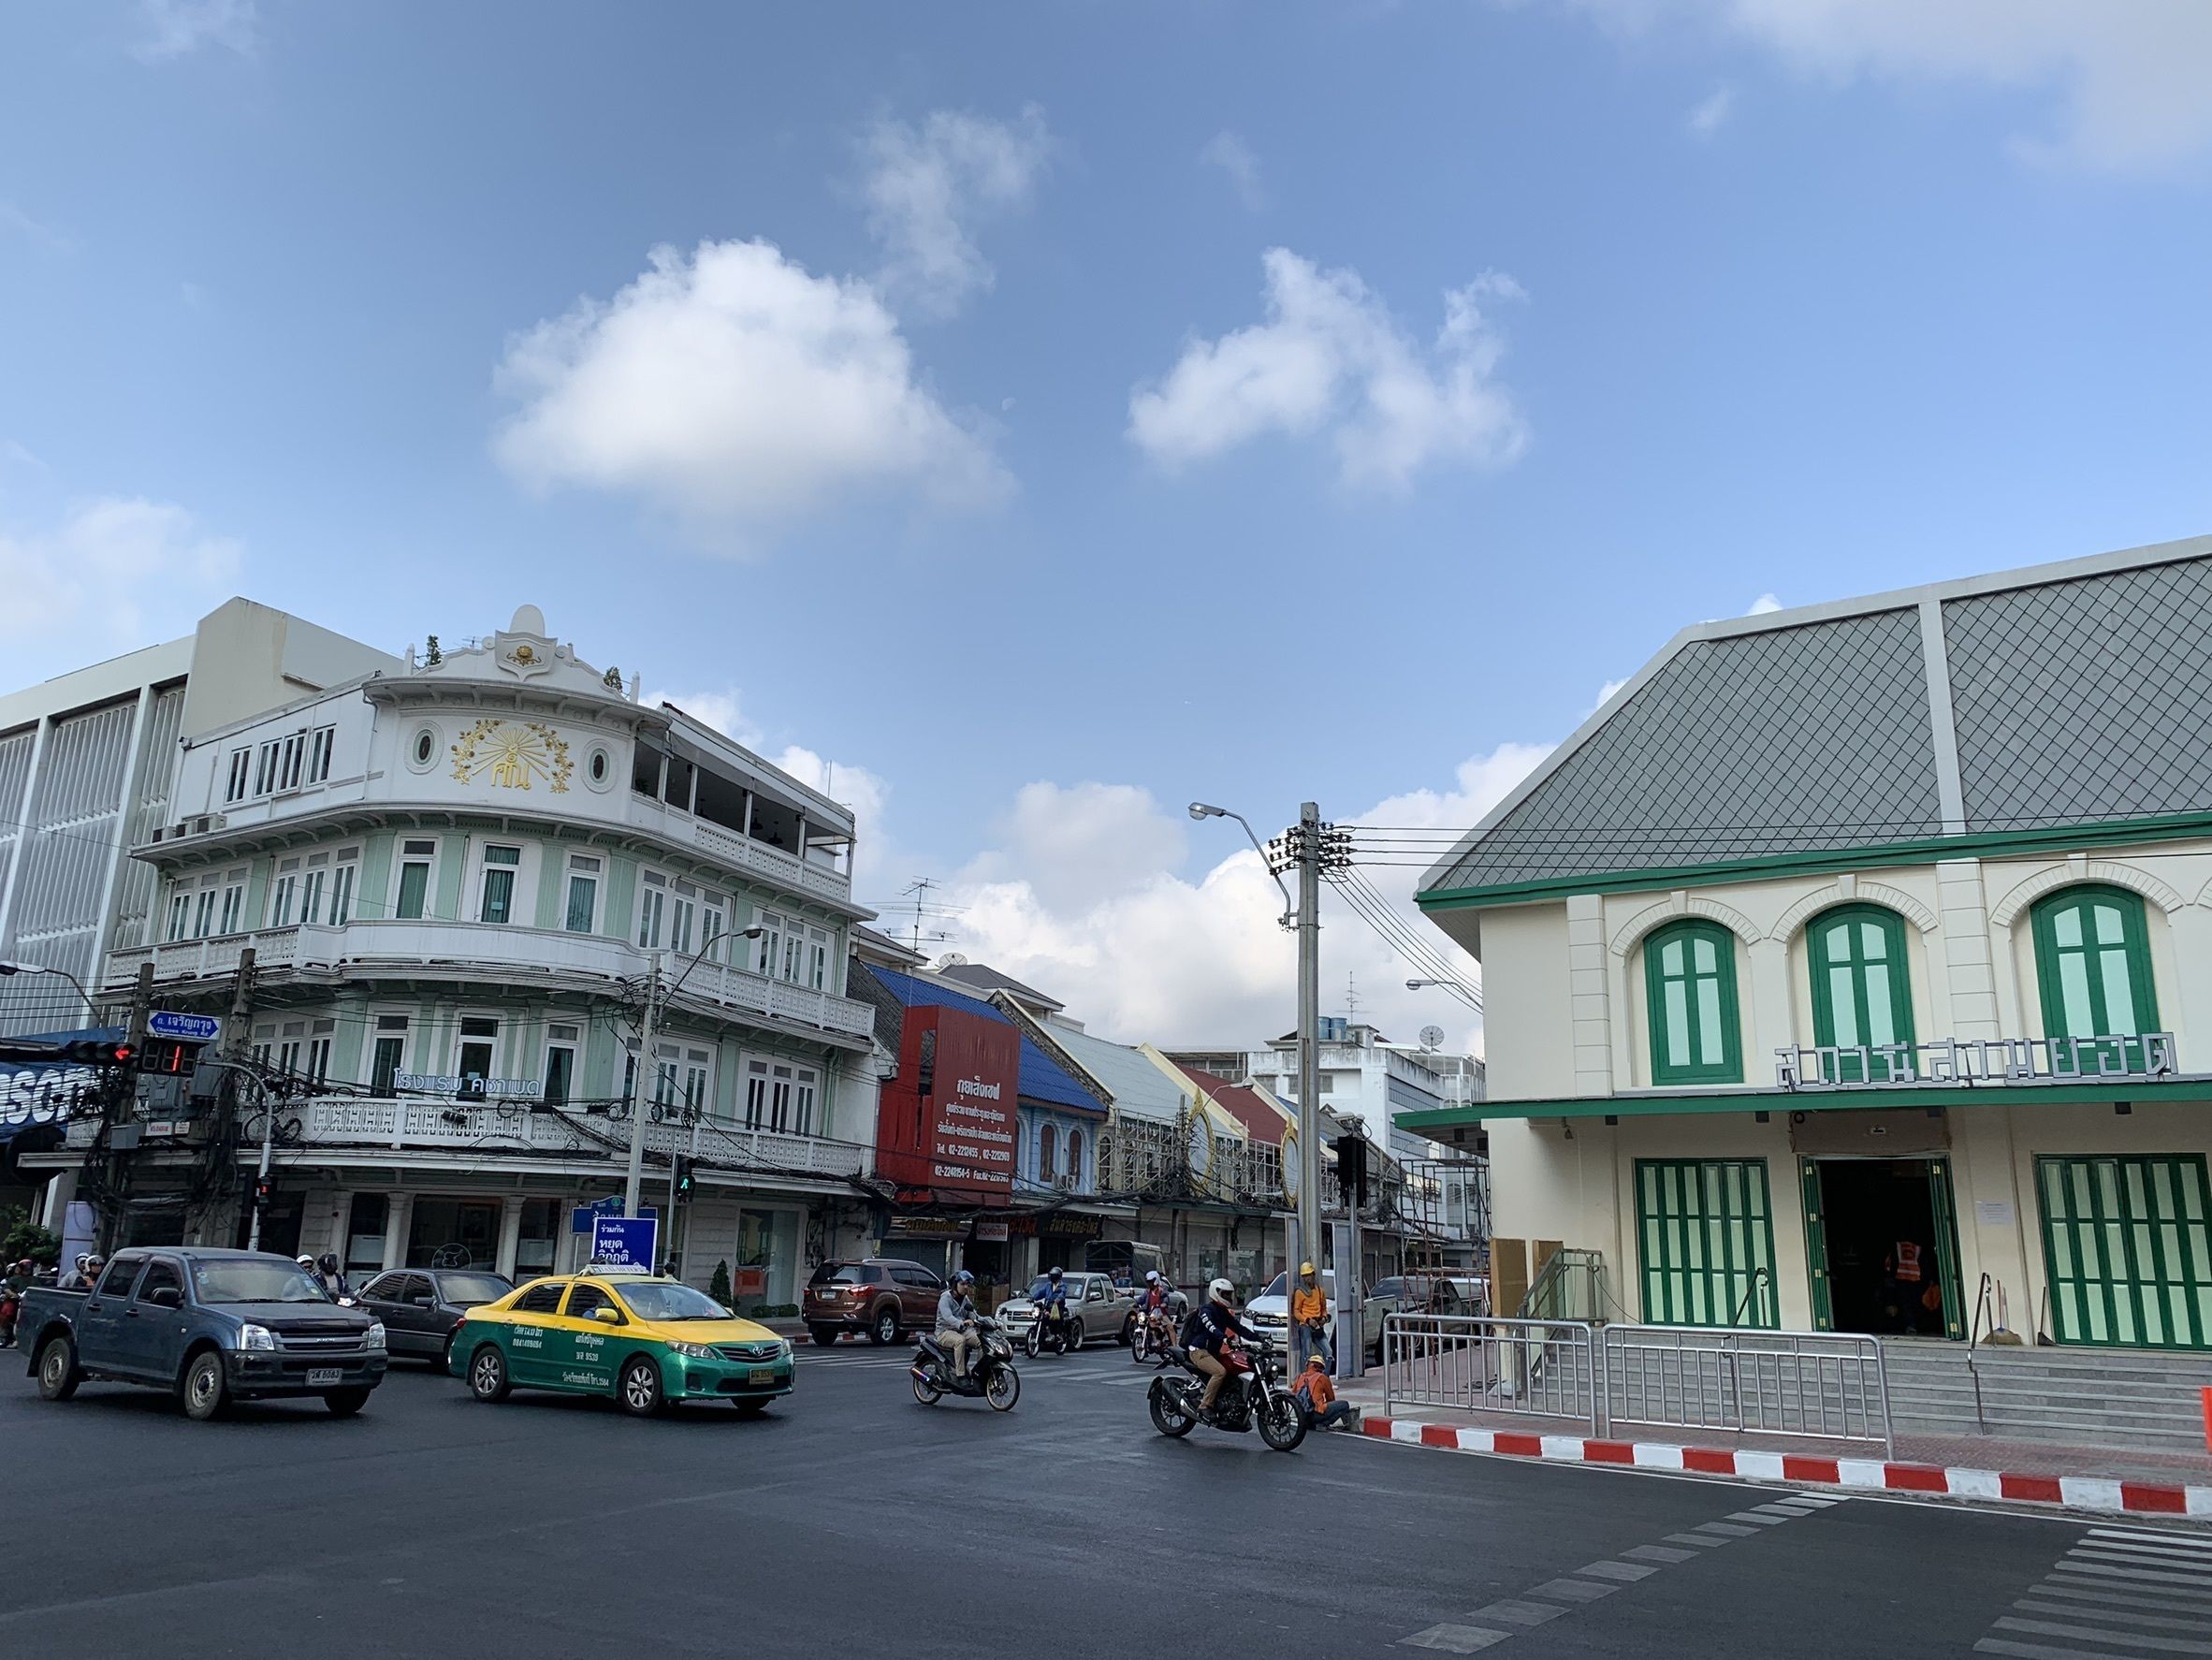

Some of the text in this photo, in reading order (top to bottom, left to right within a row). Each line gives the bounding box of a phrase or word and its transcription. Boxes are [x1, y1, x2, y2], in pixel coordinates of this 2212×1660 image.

[168, 1015, 212, 1032] เจริญกรุง
[393, 1067, 462, 1092] โรงแรม
[601, 1224, 624, 1233] ร่วมกัน
[599, 1239, 623, 1251] หยุด
